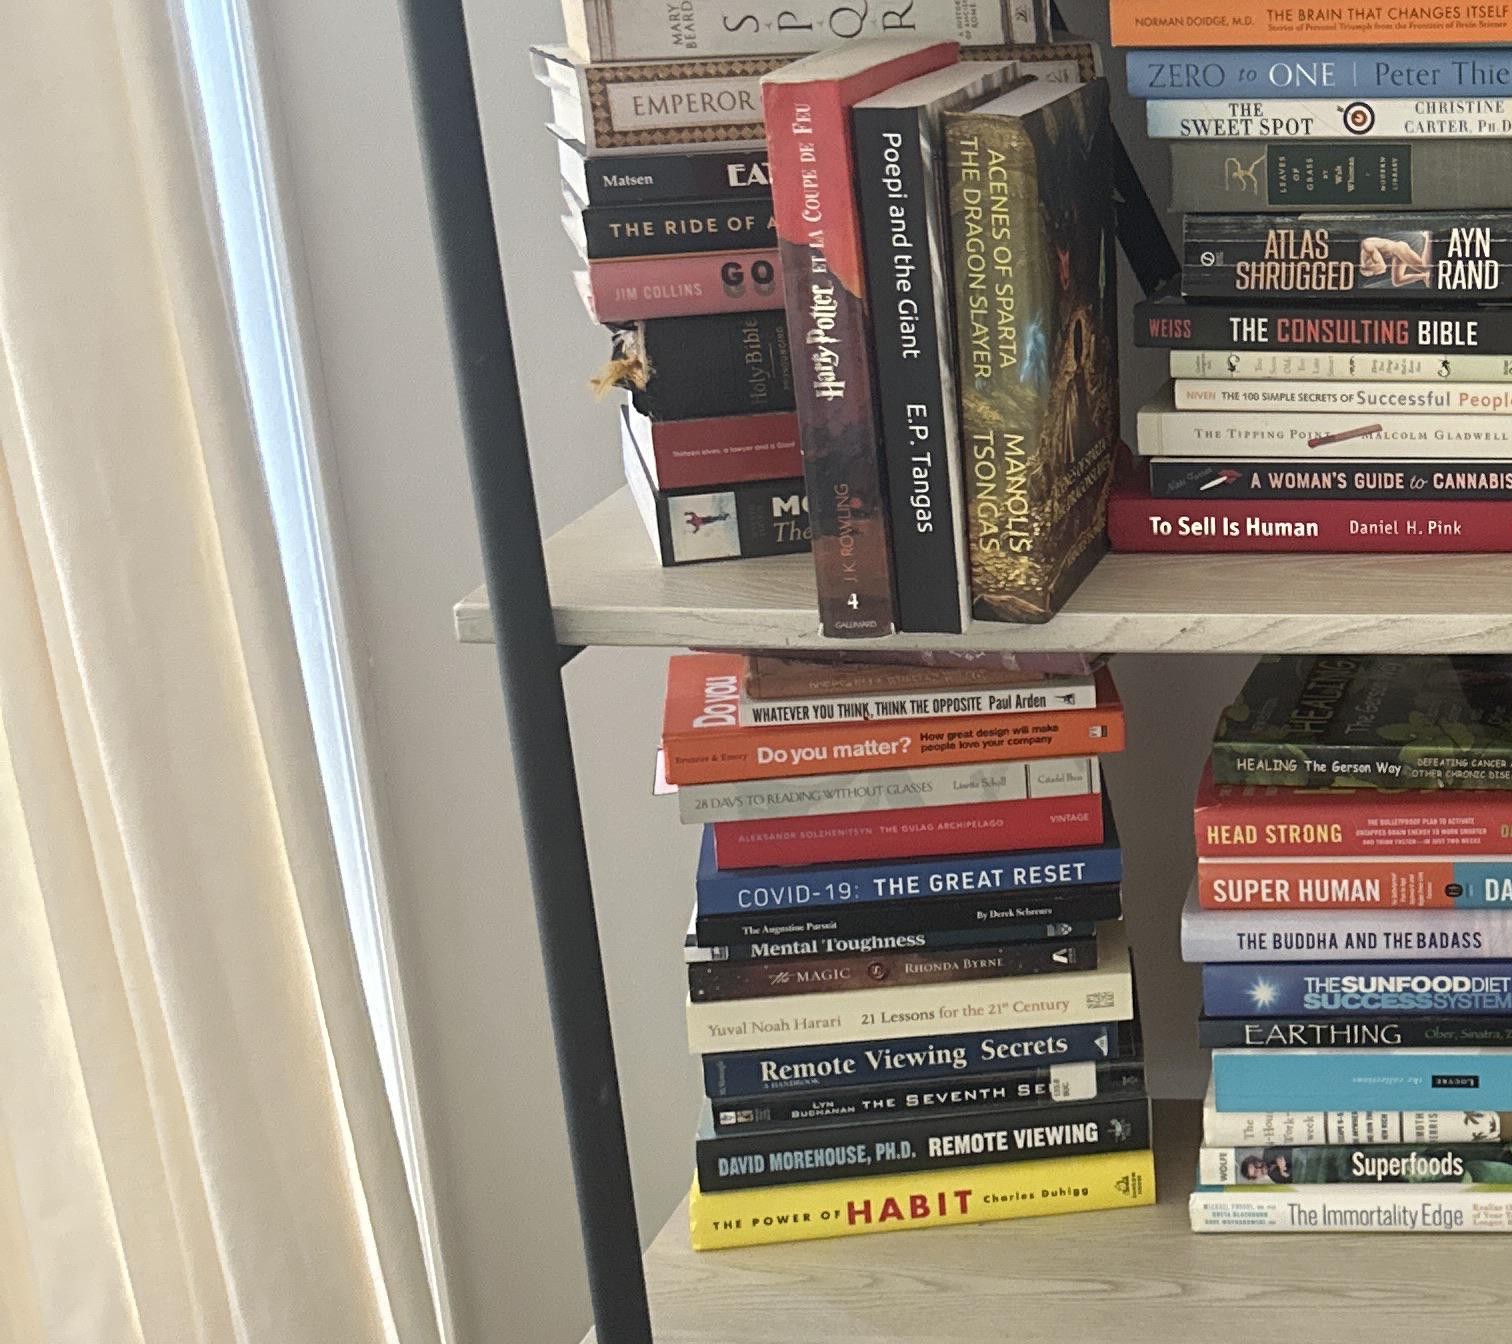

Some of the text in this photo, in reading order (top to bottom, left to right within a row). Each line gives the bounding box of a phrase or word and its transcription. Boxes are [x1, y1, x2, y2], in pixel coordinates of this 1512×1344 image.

[1148, 62, 1336, 88] ZERO to ONE
[1375, 63, 1439, 88] Peter
[633, 91, 754, 117] EMPEROR
[881, 132, 920, 360] Poepi and the Giant
[1263, 229, 1329, 260] ATLAS
[1447, 227, 1491, 258] AYN
[1236, 261, 1355, 292] SHRUGGED
[1437, 258, 1499, 291] RAND
[1149, 318, 1192, 339] WEISS
[1230, 317, 1478, 345] THE CONSULTING BIBLE
[906, 403, 934, 533] E.P. Tangas
[1251, 473, 1262, 489] A
[1267, 472, 1346, 490] WOMAN'S
[1354, 472, 1405, 490] GUIDE
[1410, 475, 1428, 490] to
[1149, 516, 1319, 537] To Sell Is Human
[1207, 824, 1342, 844] HEAD STRONG
[738, 863, 1086, 909] COVID-19: THE GREAT RESET
[1213, 879, 1293, 903] SUPER
[1299, 879, 1381, 902] HUMAN
[1244, 1023, 1402, 1045] EARTHING
[761, 1034, 1068, 1081] Remote Viewing Secrets
[1352, 1152, 1464, 1179] Superfoods
[713, 1189, 973, 1230] THE POWER OF HABIT
[1288, 1204, 1318, 1225] The
[1322, 1203, 1417, 1227] Immortality
[1421, 1204, 1463, 1227] Edge
